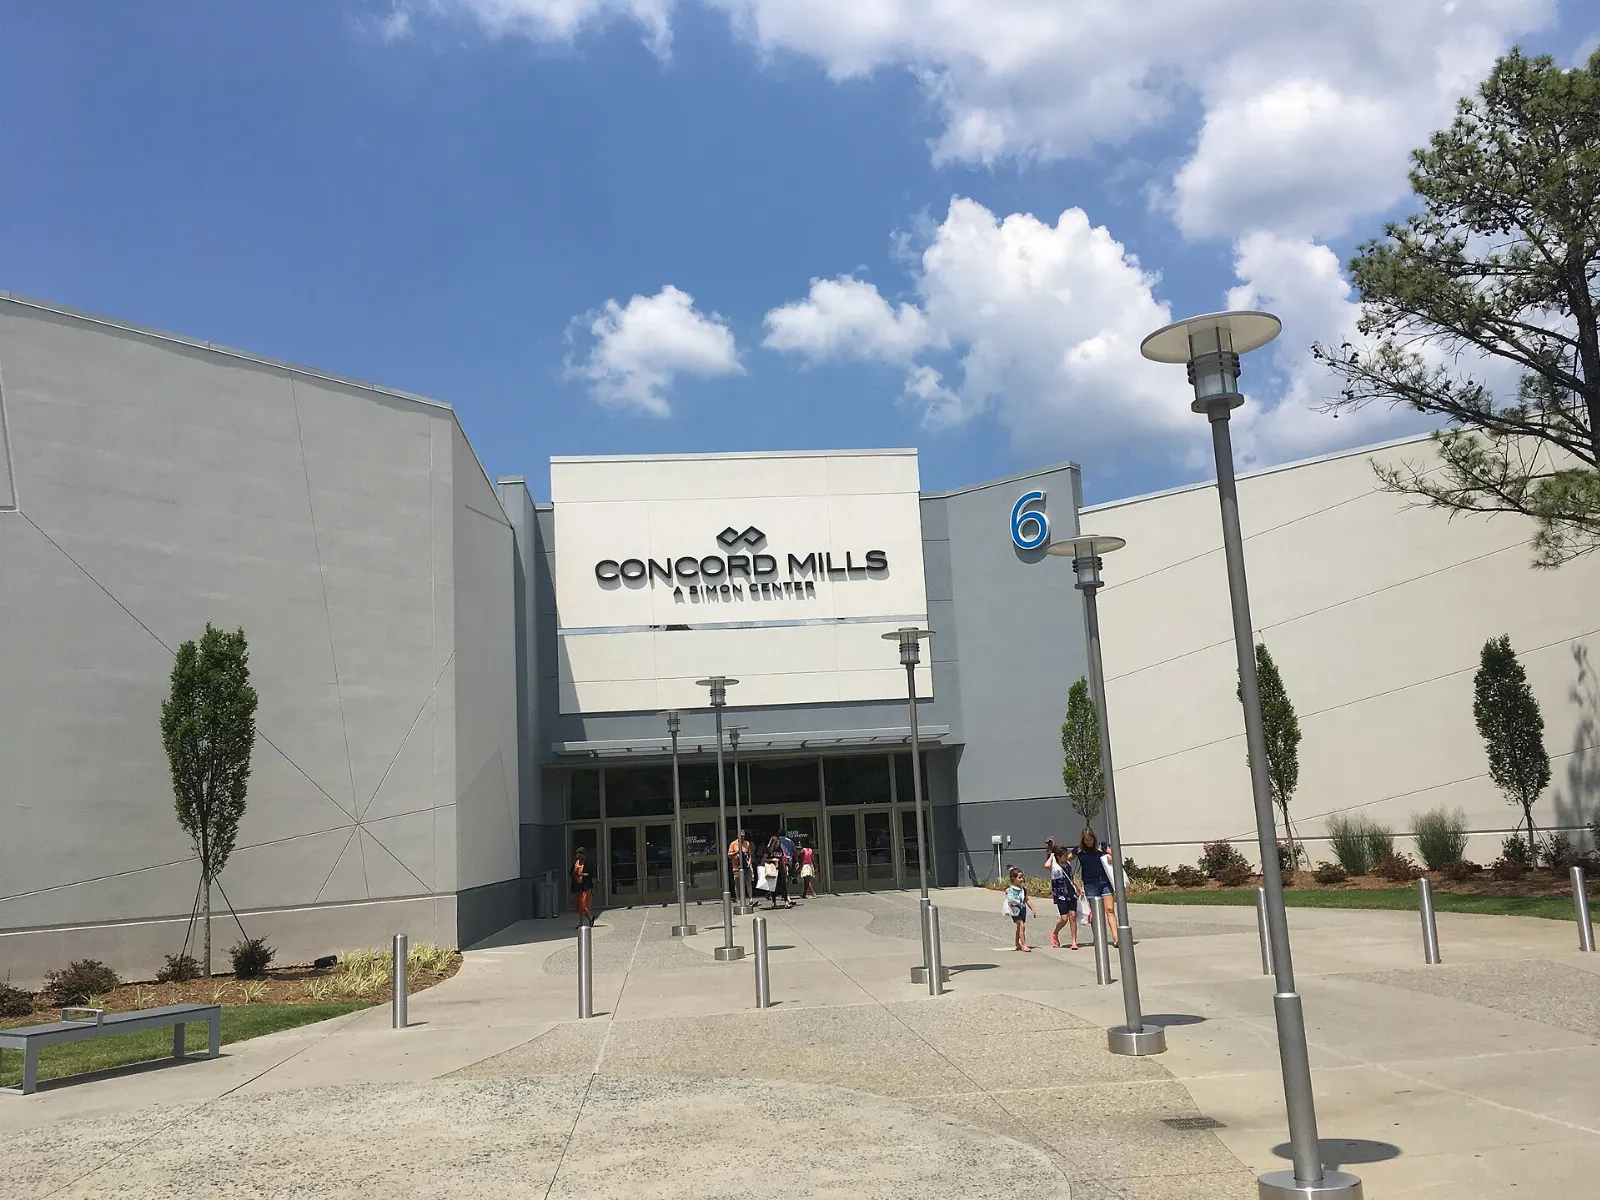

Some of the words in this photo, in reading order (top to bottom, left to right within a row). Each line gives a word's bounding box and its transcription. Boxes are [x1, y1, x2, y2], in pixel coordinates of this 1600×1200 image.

[1010, 490, 1050, 549] 6
[595, 554, 777, 581] CONCORD
[788, 550, 888, 574] MILLS
[673, 586, 683, 596] A
[689, 584, 742, 595] SIMON
[749, 581, 815, 592] CENTER
[667, 800, 712, 809] EPRESS
